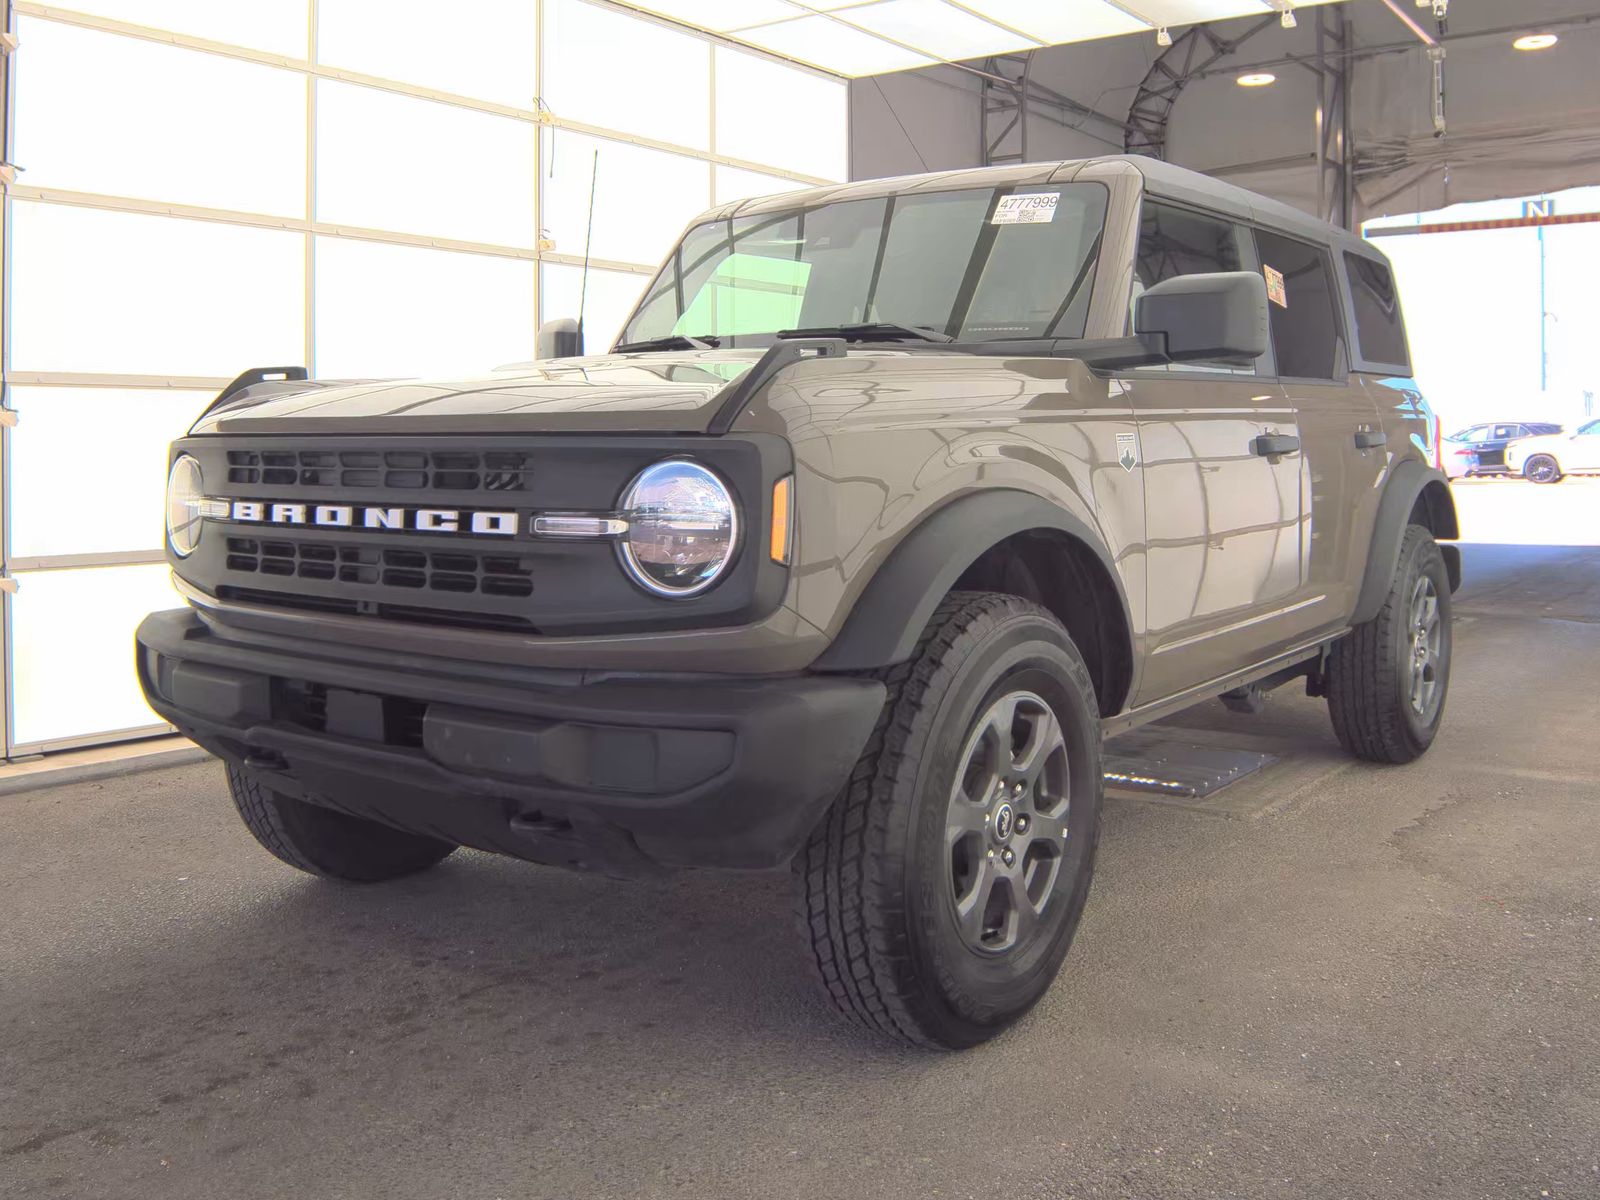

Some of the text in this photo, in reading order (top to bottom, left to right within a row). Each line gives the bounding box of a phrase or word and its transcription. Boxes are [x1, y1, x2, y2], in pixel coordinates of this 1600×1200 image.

[1000, 196, 1058, 210] 4777999
[1527, 200, 1549, 218] N
[232, 501, 519, 535] BRONCO
